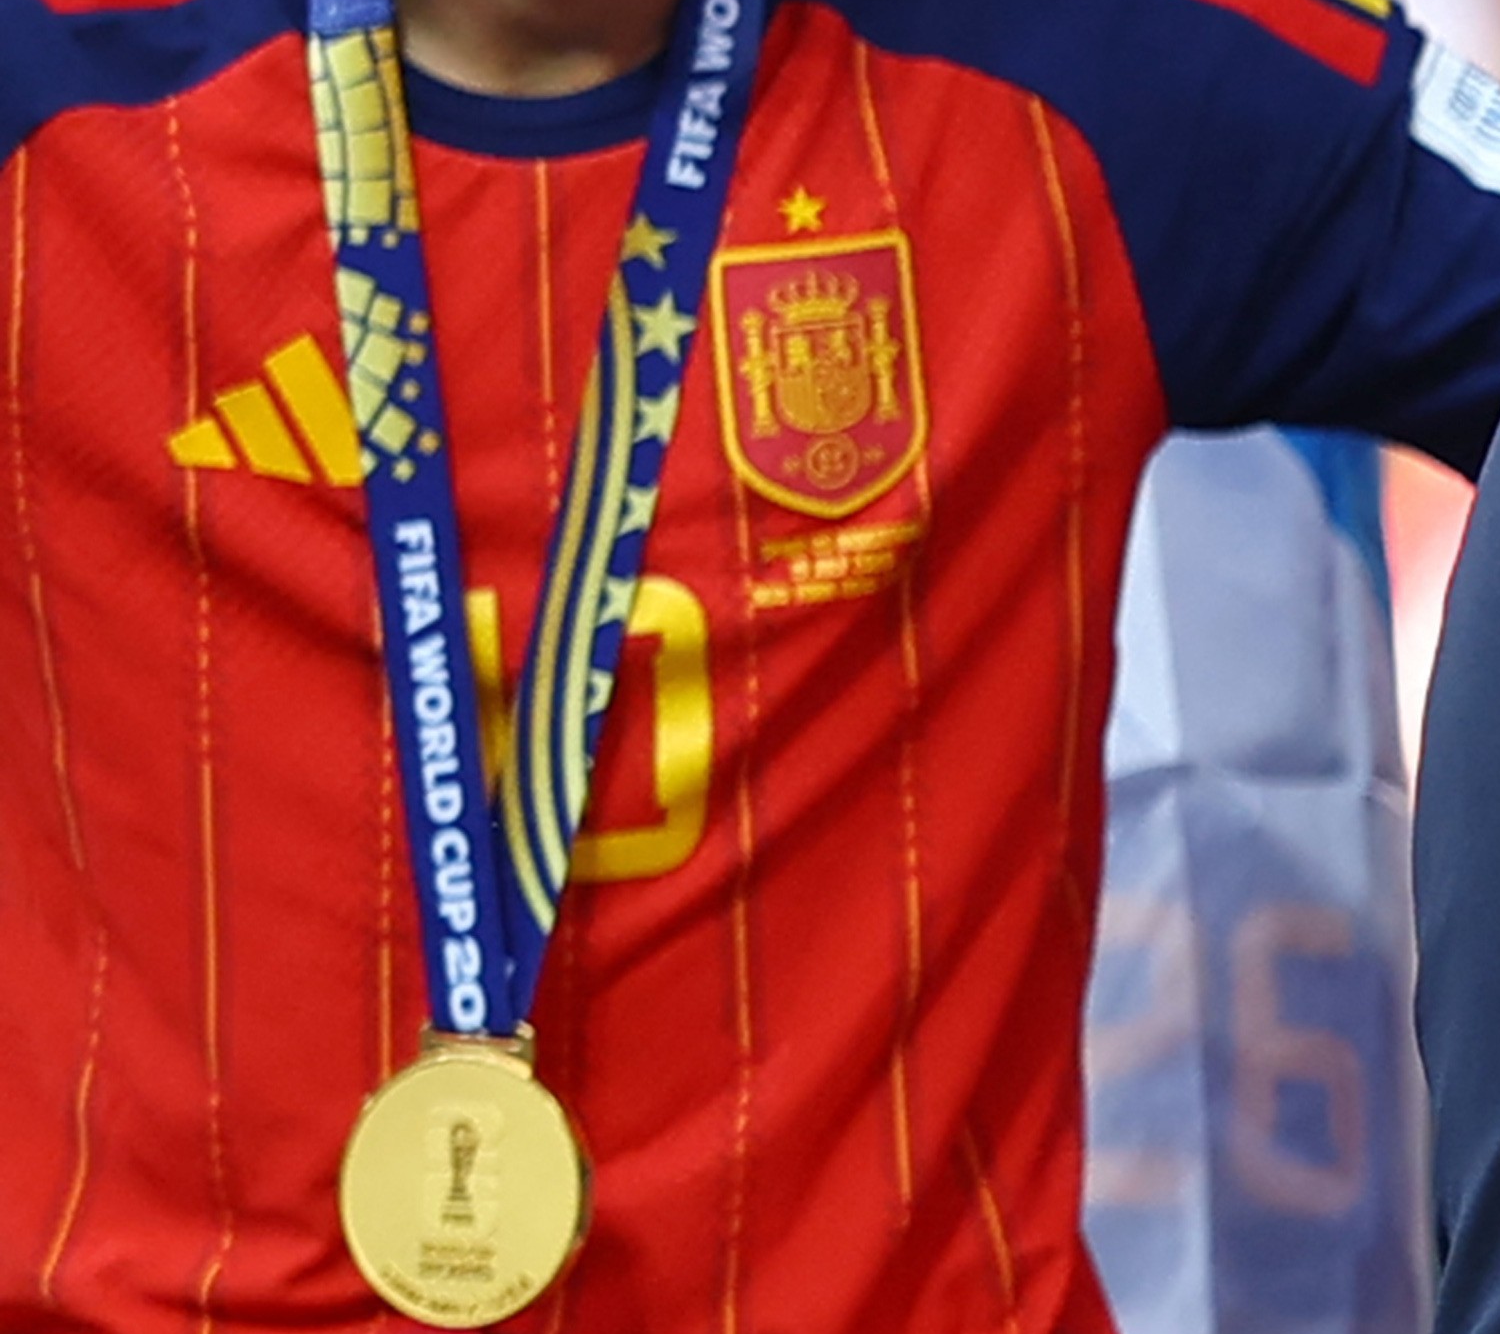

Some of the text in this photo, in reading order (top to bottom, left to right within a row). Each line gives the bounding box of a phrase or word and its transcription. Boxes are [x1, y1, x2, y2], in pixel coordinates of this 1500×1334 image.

[665, 76, 728, 190] FIFA
[394, 517, 489, 1033] FIFA WORLD CUP 20
